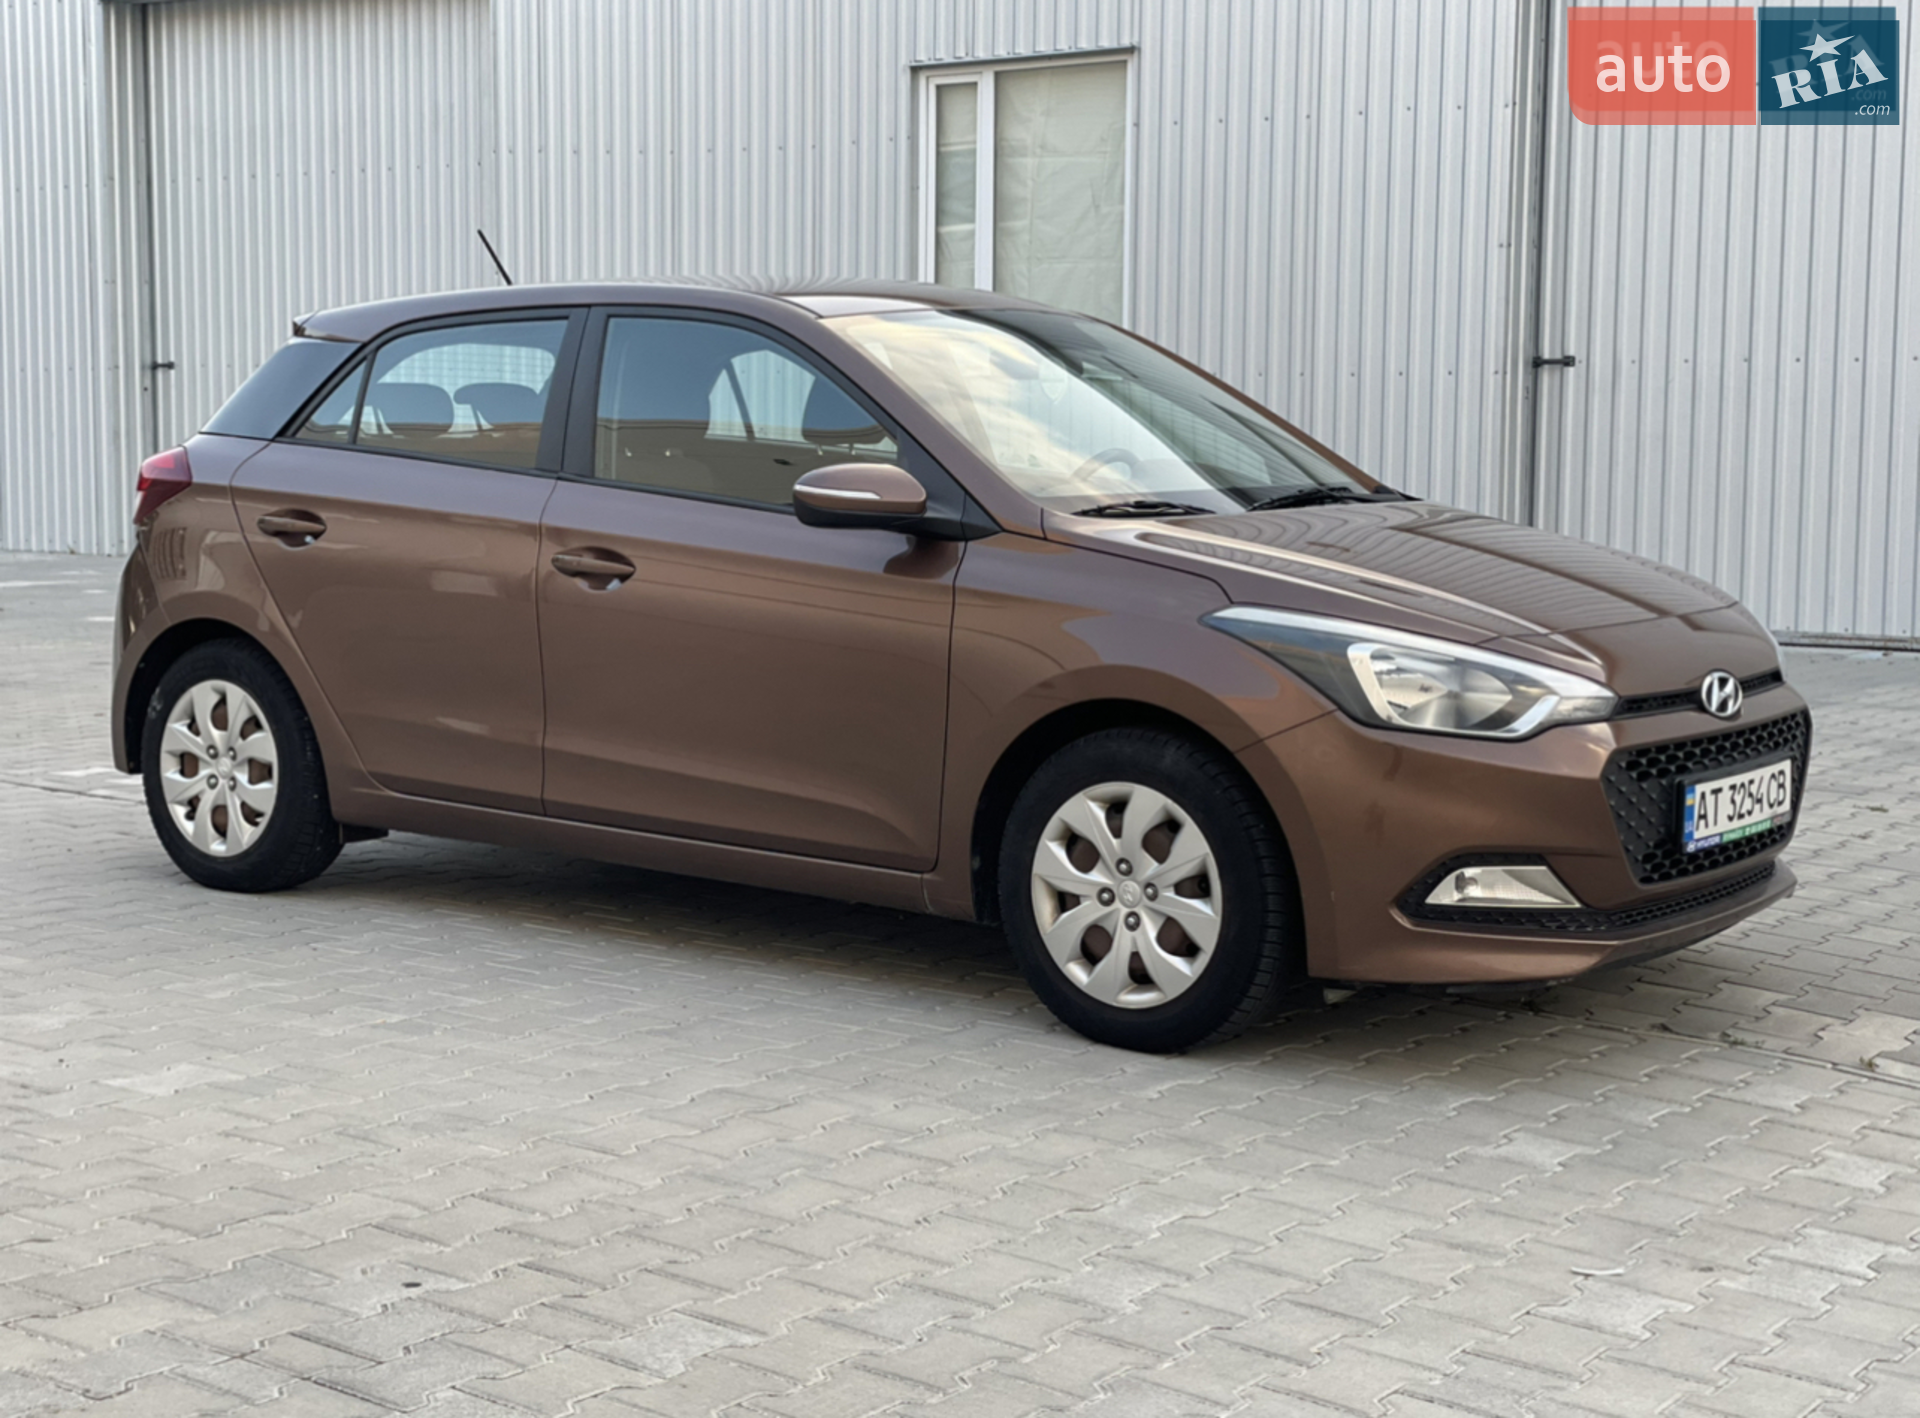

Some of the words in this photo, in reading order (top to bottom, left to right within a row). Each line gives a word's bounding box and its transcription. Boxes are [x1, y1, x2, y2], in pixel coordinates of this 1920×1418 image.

[1696, 787, 1723, 831] AT
[1727, 776, 1764, 822] 3254
[1767, 769, 1786, 809] CB
